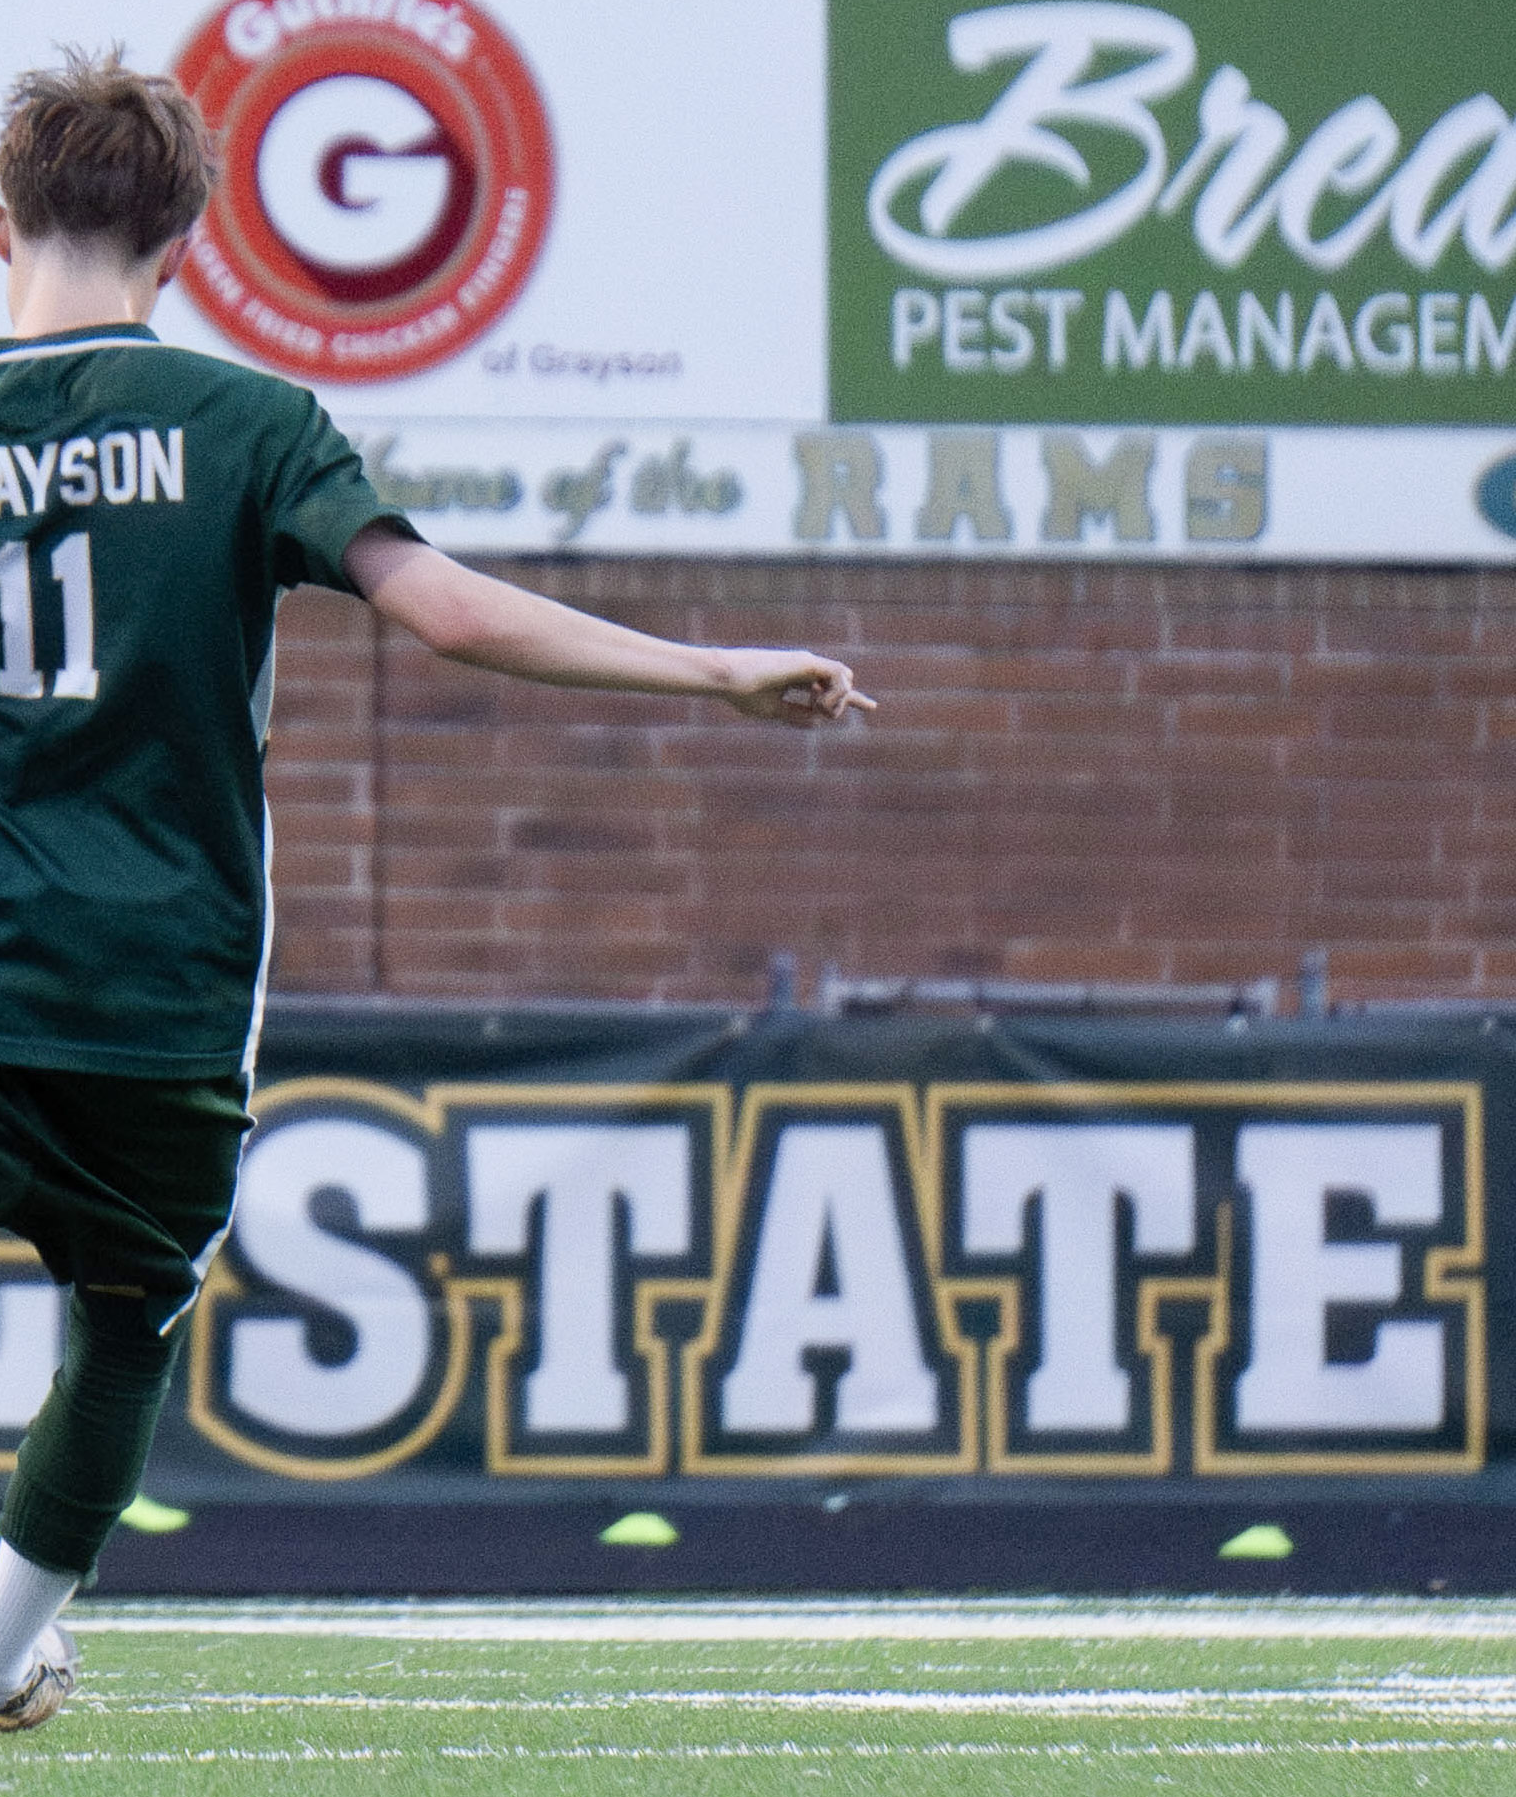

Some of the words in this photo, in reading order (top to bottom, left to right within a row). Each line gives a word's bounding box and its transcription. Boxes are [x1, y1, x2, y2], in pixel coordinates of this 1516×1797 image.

[256, 71, 452, 275] G
[892, 288, 1084, 373] PEST
[1100, 289, 1516, 376] MANAGEM
[790, 430, 1274, 541] RAMS
[228, 1117, 1446, 1438] STATE
